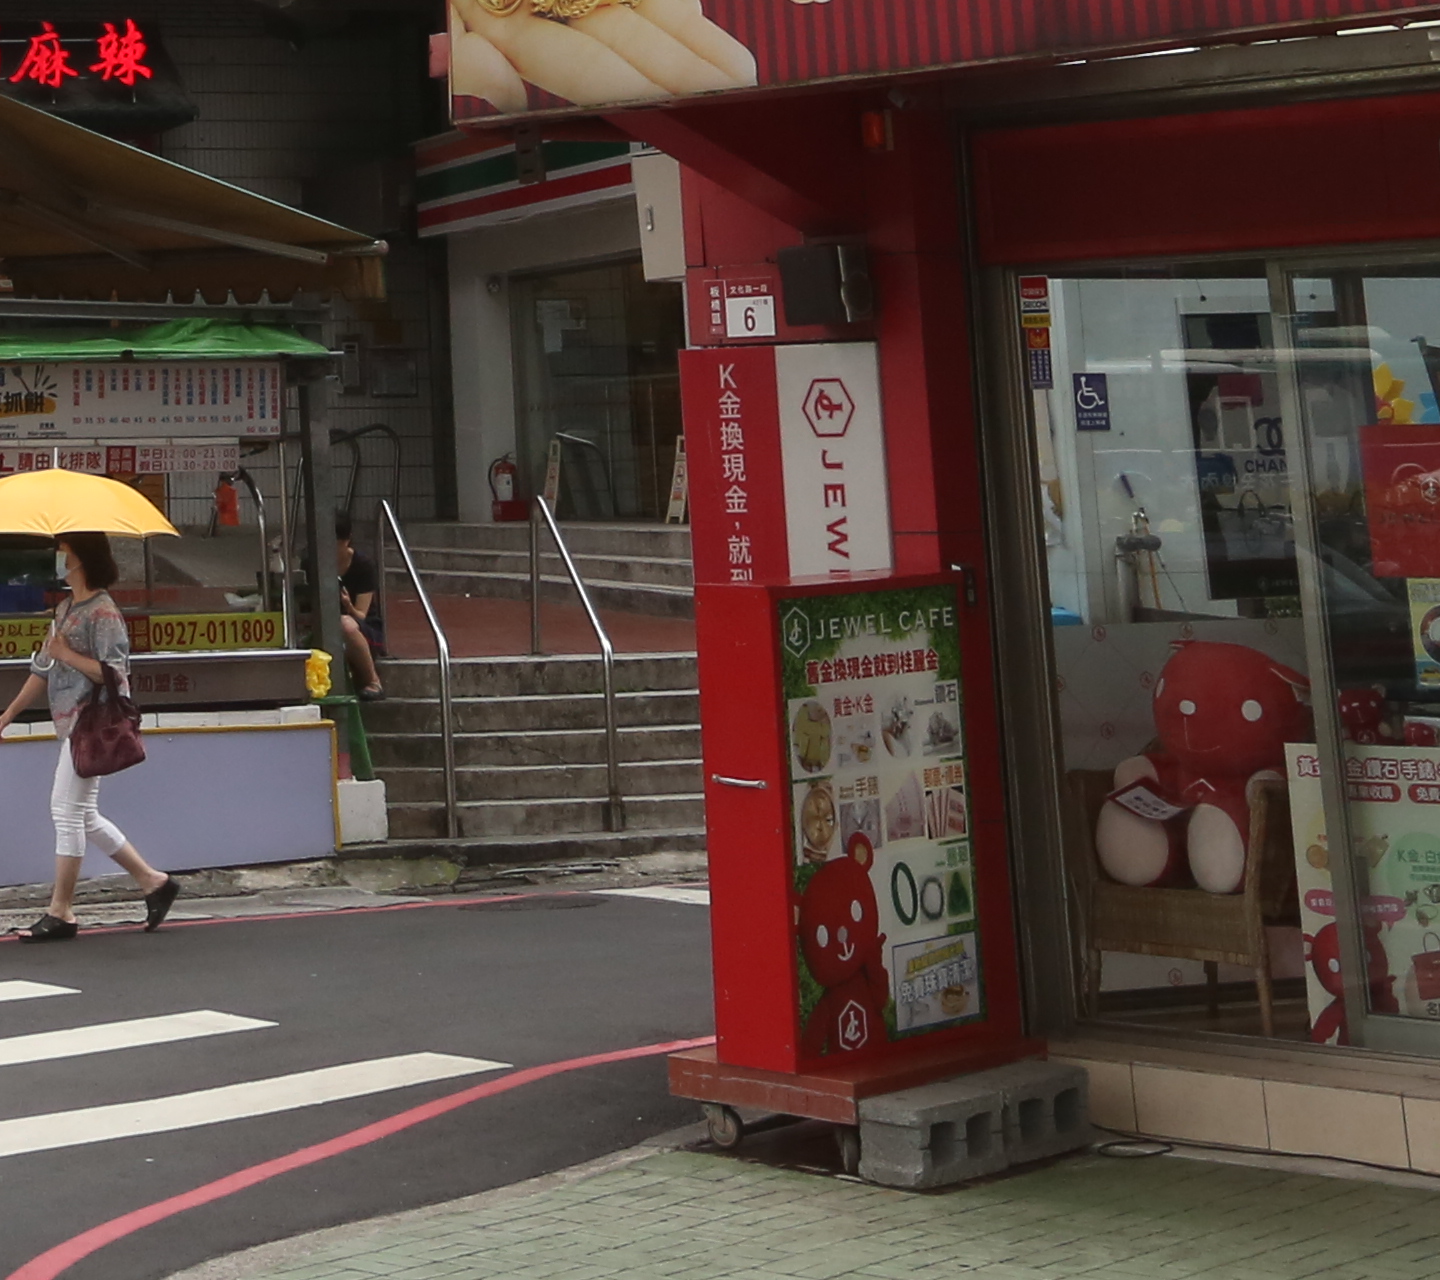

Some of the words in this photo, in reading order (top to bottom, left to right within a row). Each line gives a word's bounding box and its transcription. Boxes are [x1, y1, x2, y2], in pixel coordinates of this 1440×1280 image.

[744, 306, 756, 332] 6
[821, 449, 851, 575] JEW
[152, 618, 276, 646] 0927-011809
[815, 613, 893, 640] JEWEL
[898, 606, 955, 632] CAFE
